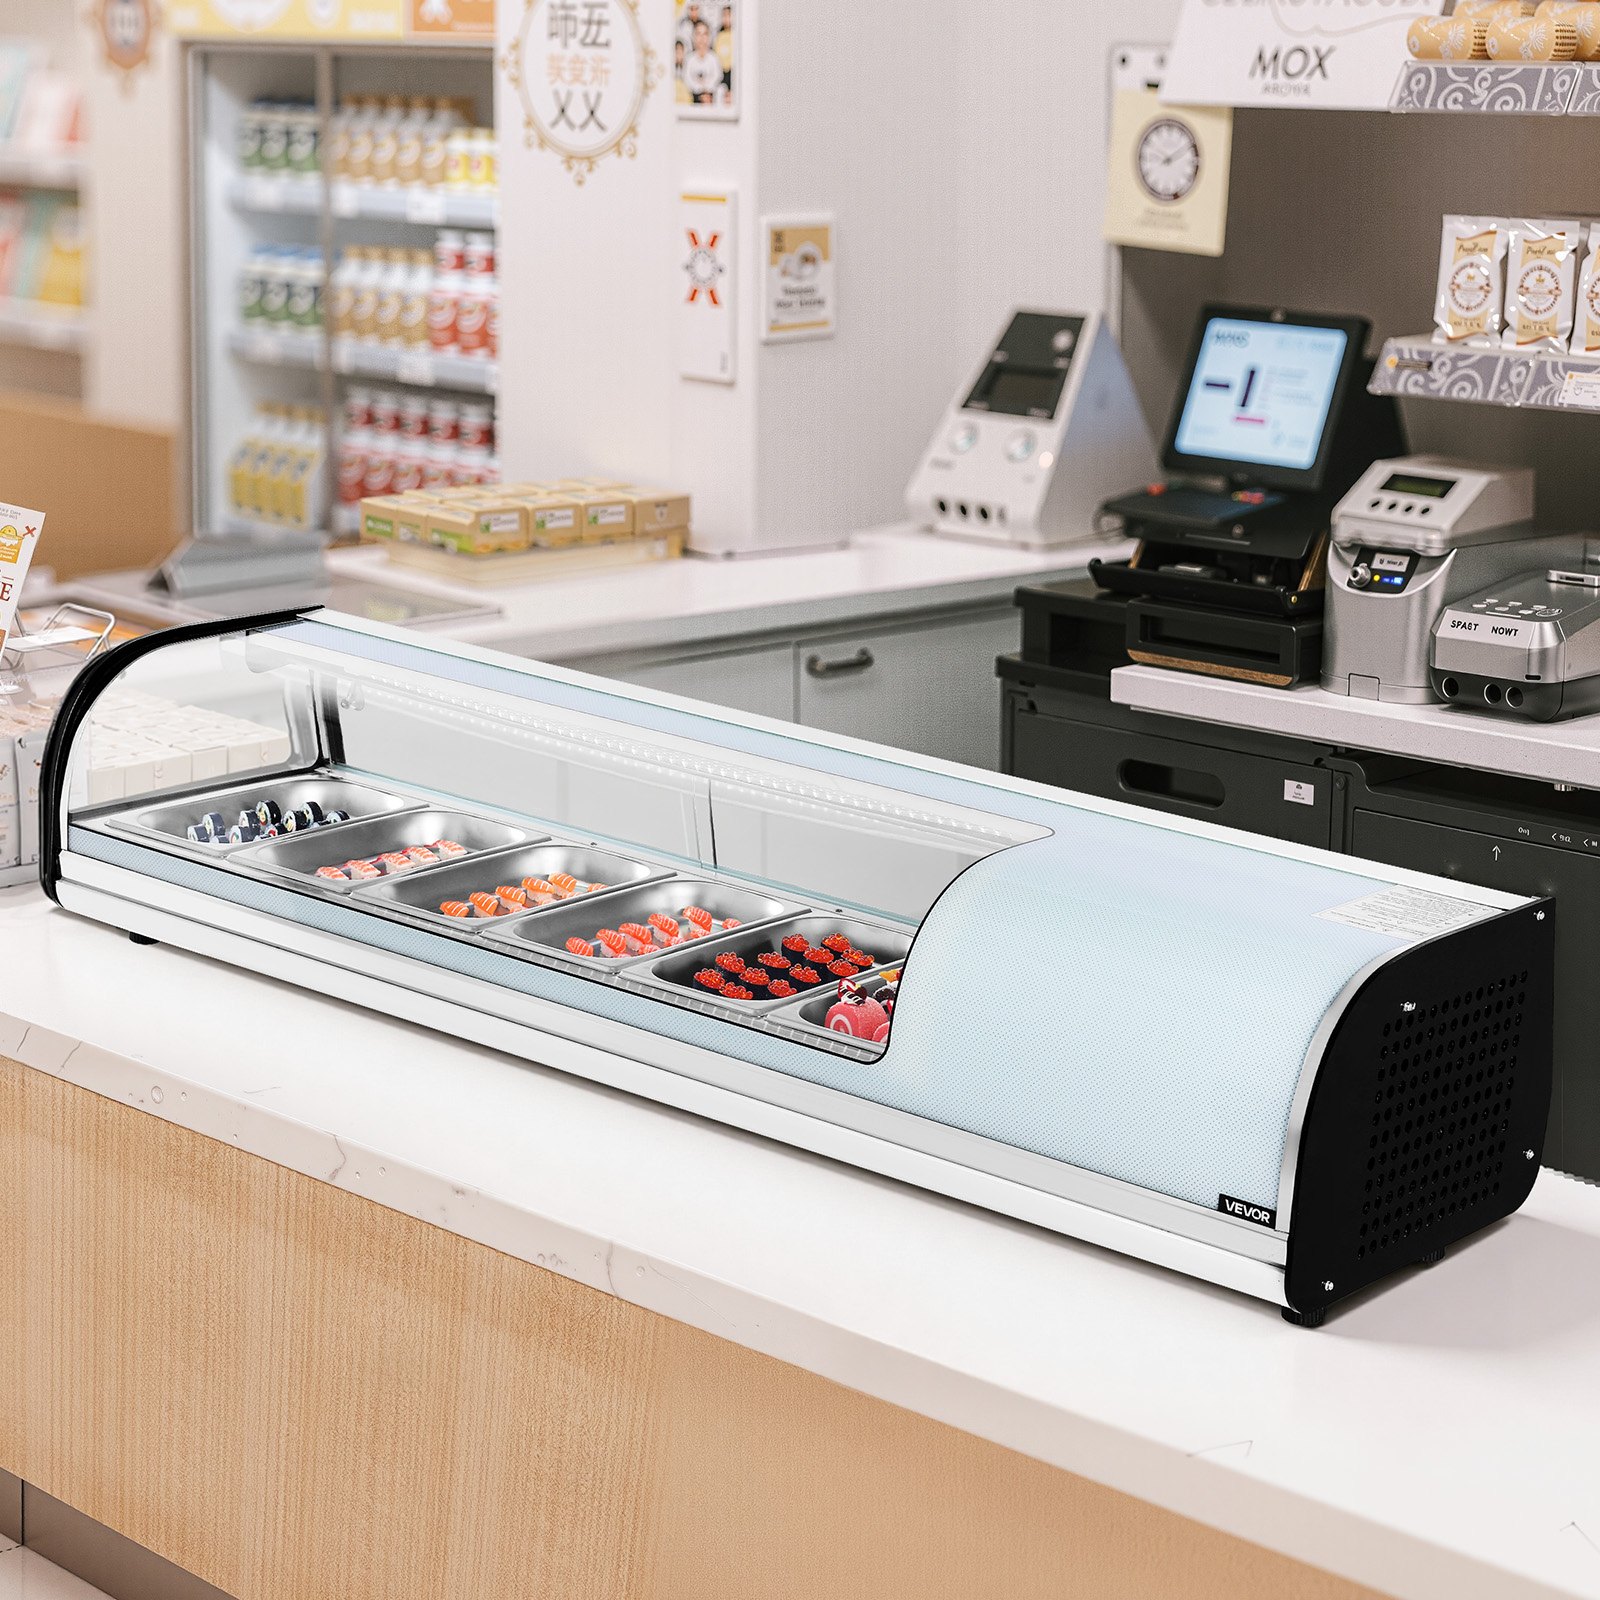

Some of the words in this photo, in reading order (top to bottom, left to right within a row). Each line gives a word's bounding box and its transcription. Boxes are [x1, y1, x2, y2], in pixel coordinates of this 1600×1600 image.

[1249, 46, 1337, 80] MOX
[1490, 625, 1519, 637] NOWT
[1225, 1198, 1270, 1224] VEVOR
